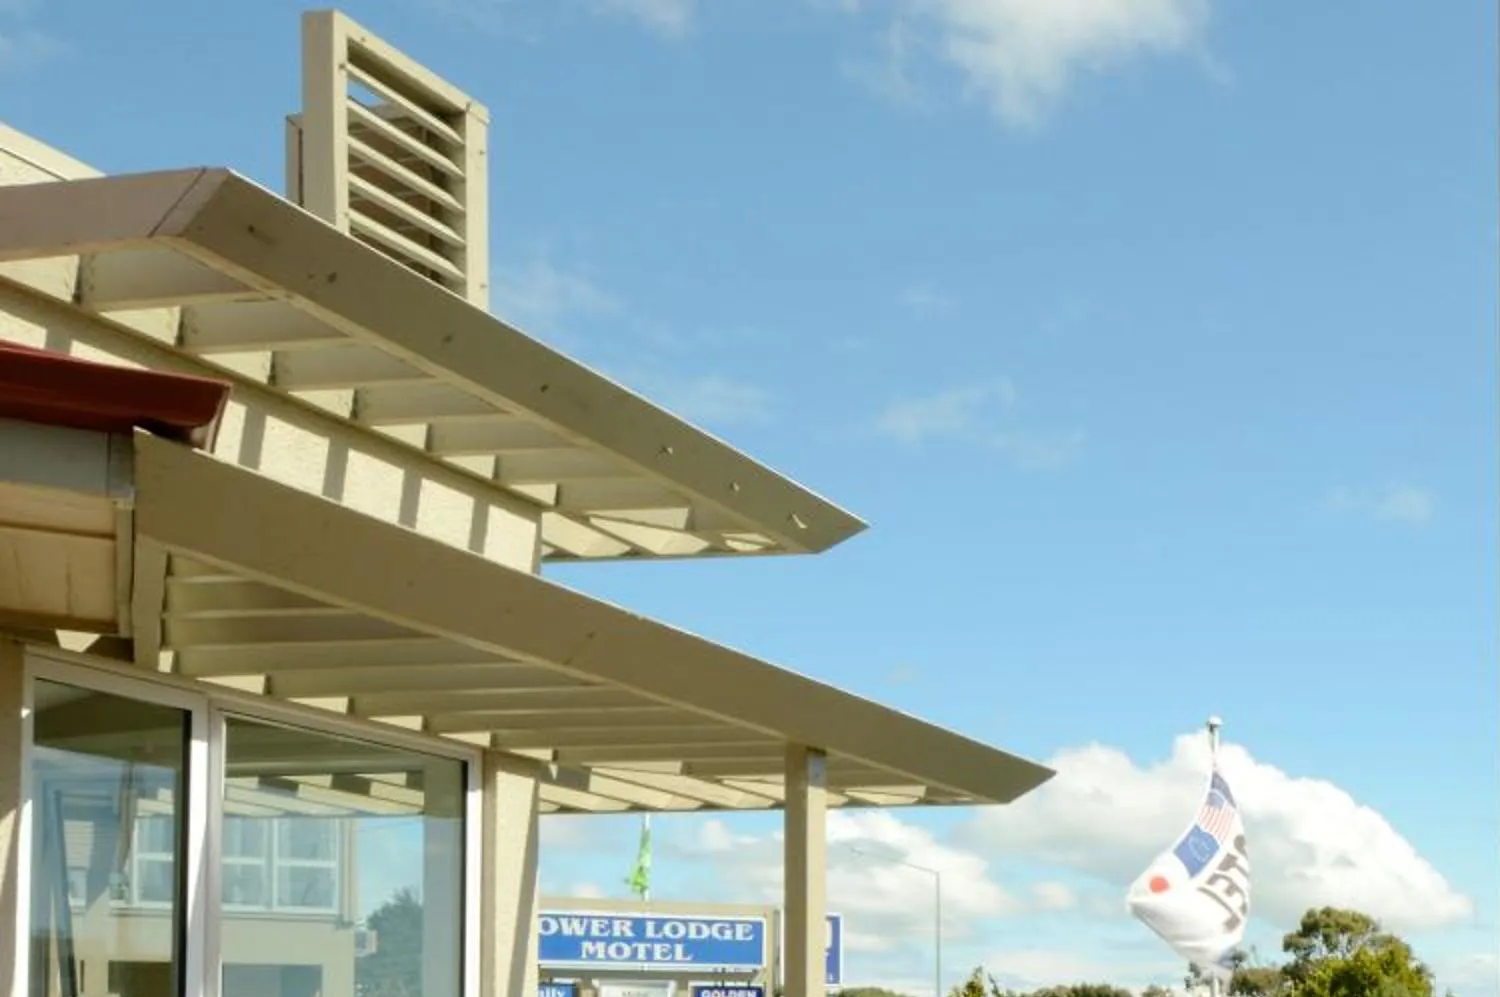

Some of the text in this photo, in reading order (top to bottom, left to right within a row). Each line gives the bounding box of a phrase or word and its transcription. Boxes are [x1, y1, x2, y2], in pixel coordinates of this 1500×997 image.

[538, 916, 755, 941] OWER LODGE
[580, 941, 694, 962] MOTEL
